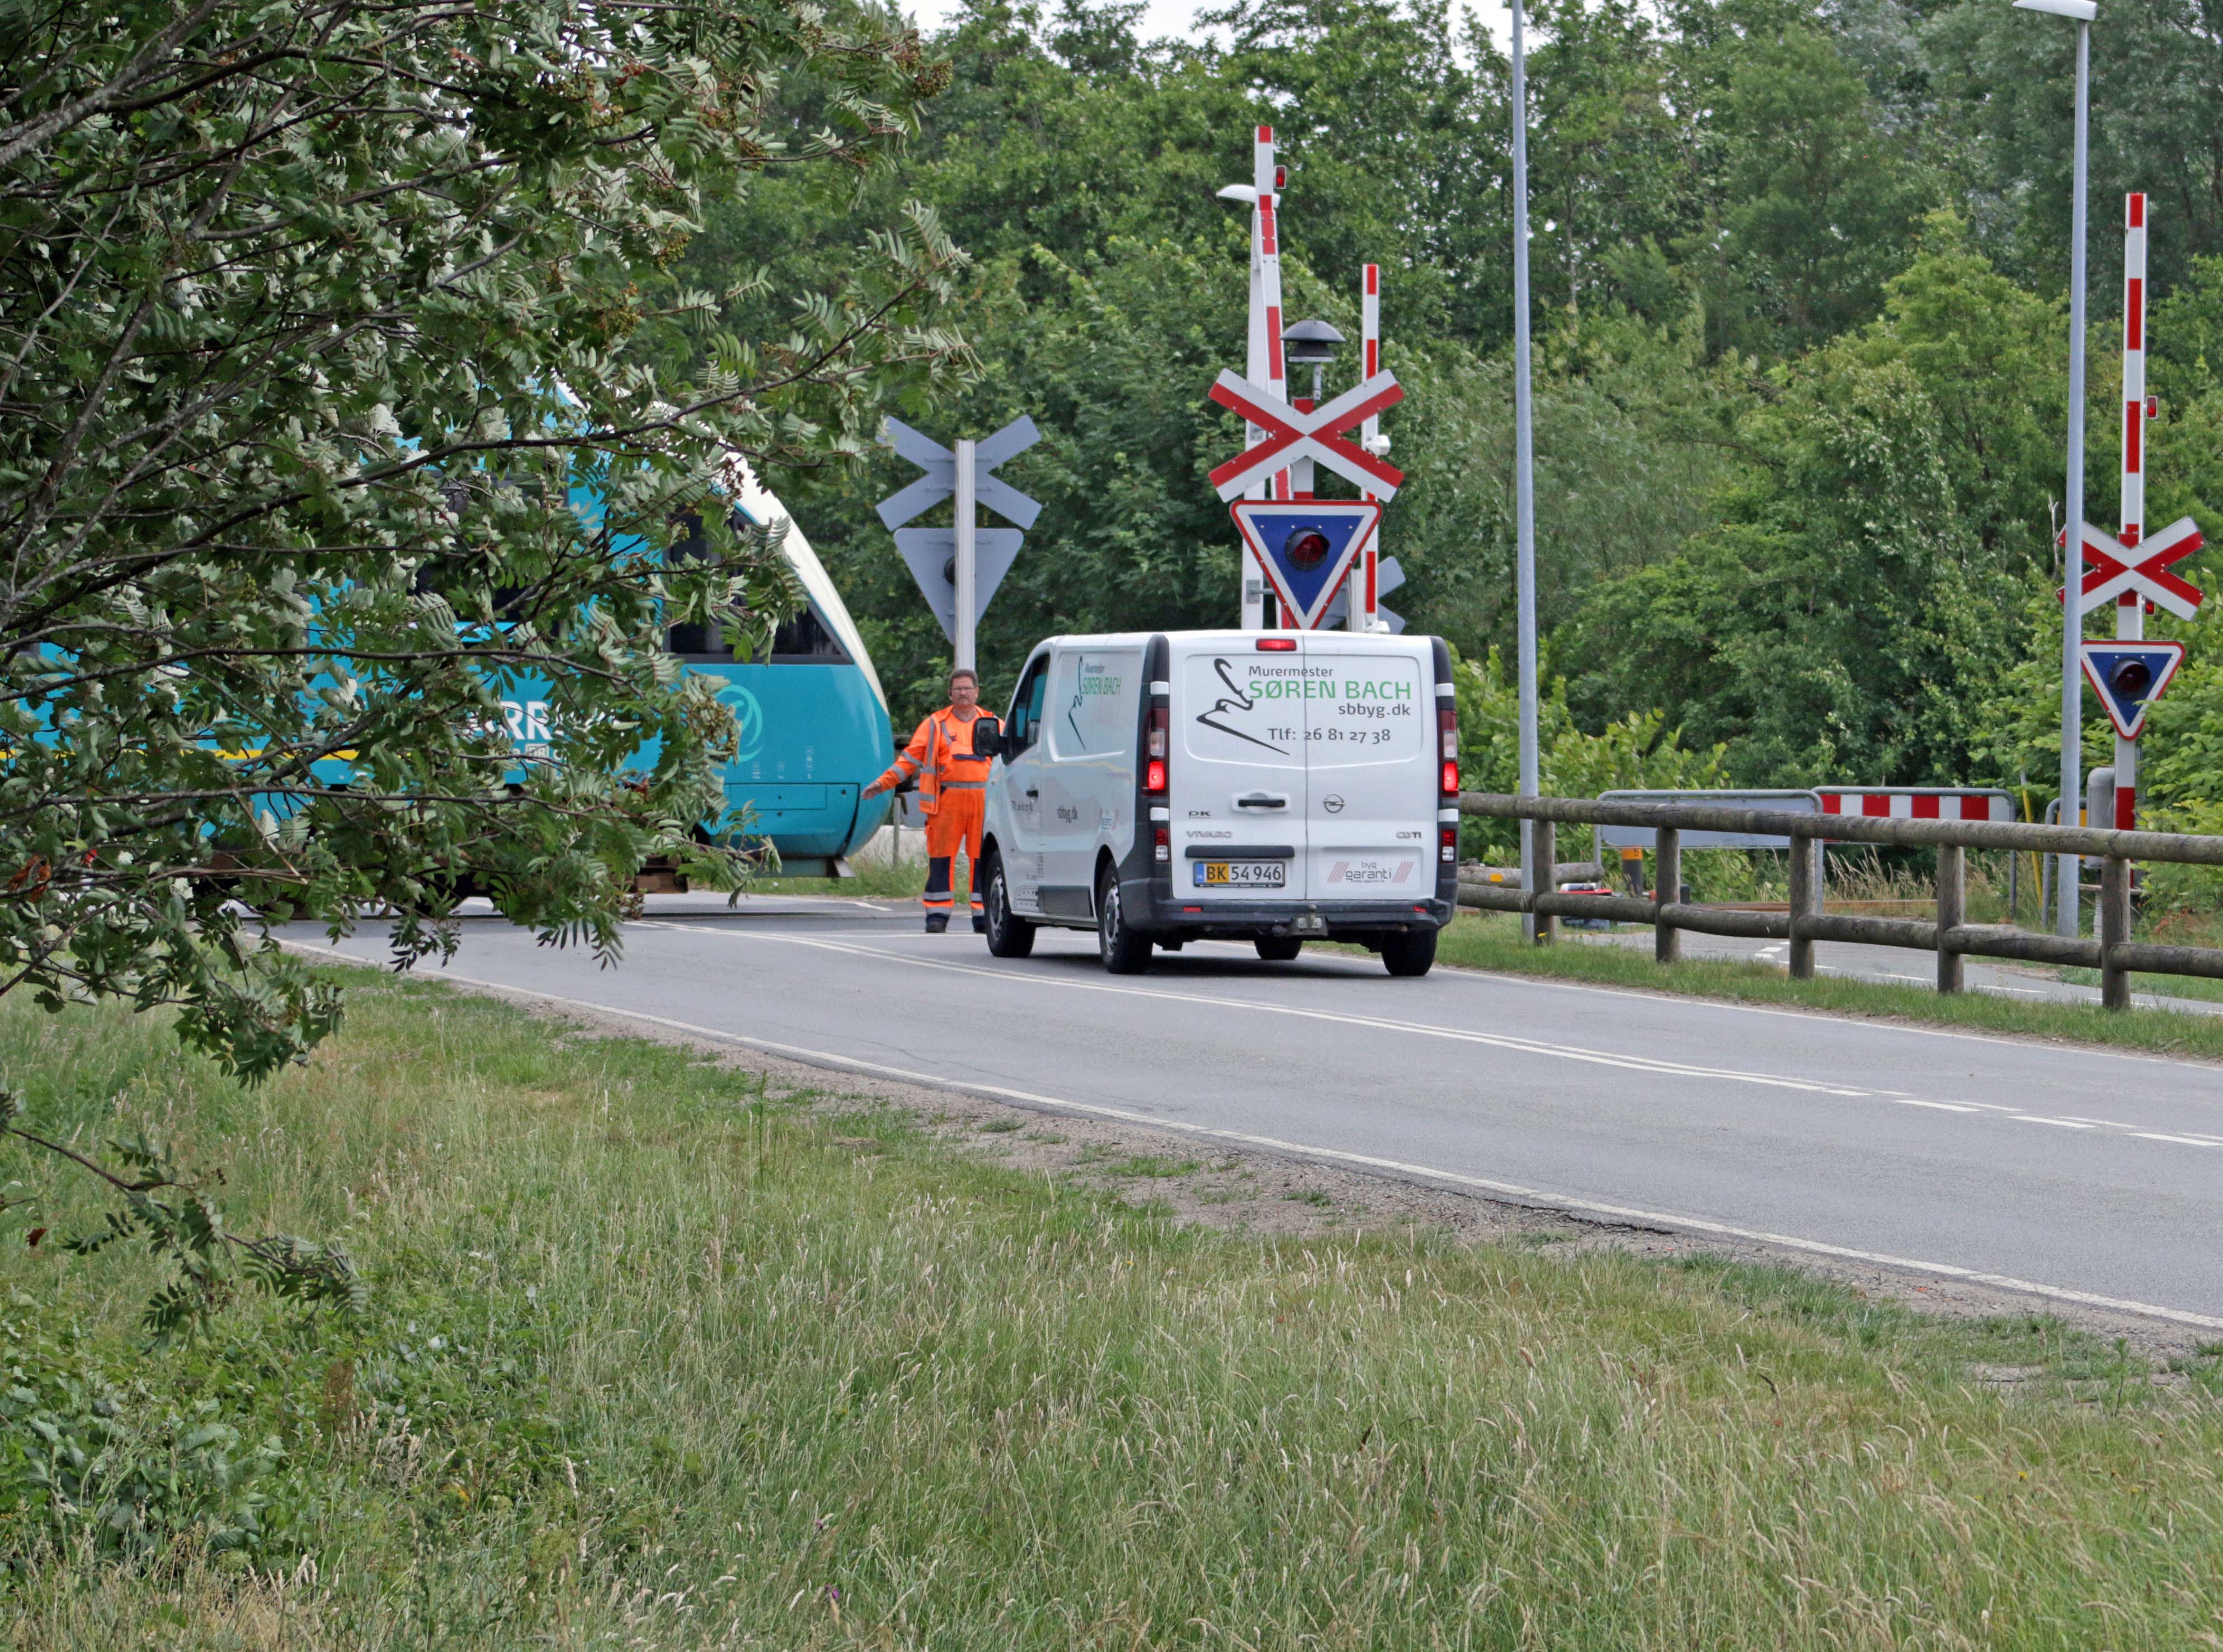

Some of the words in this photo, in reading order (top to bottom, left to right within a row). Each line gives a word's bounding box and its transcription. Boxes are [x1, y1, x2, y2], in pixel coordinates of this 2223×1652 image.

[1248, 665, 1334, 677] Murermester
[1249, 680, 1336, 699] SØREN
[1345, 681, 1411, 700] BACH
[1338, 703, 1411, 718] sbbyg.dk
[1267, 728, 1296, 741] Tlf:
[1303, 728, 1322, 741] 26
[1327, 728, 1343, 741] 81
[1349, 731, 1367, 744] 27
[1372, 729, 1391, 745] 38
[1360, 860, 1377, 869] byg
[1206, 866, 1227, 881] BK
[1231, 866, 1250, 881] 54
[1254, 866, 1282, 881] 946
[1345, 868, 1392, 883] garanti
